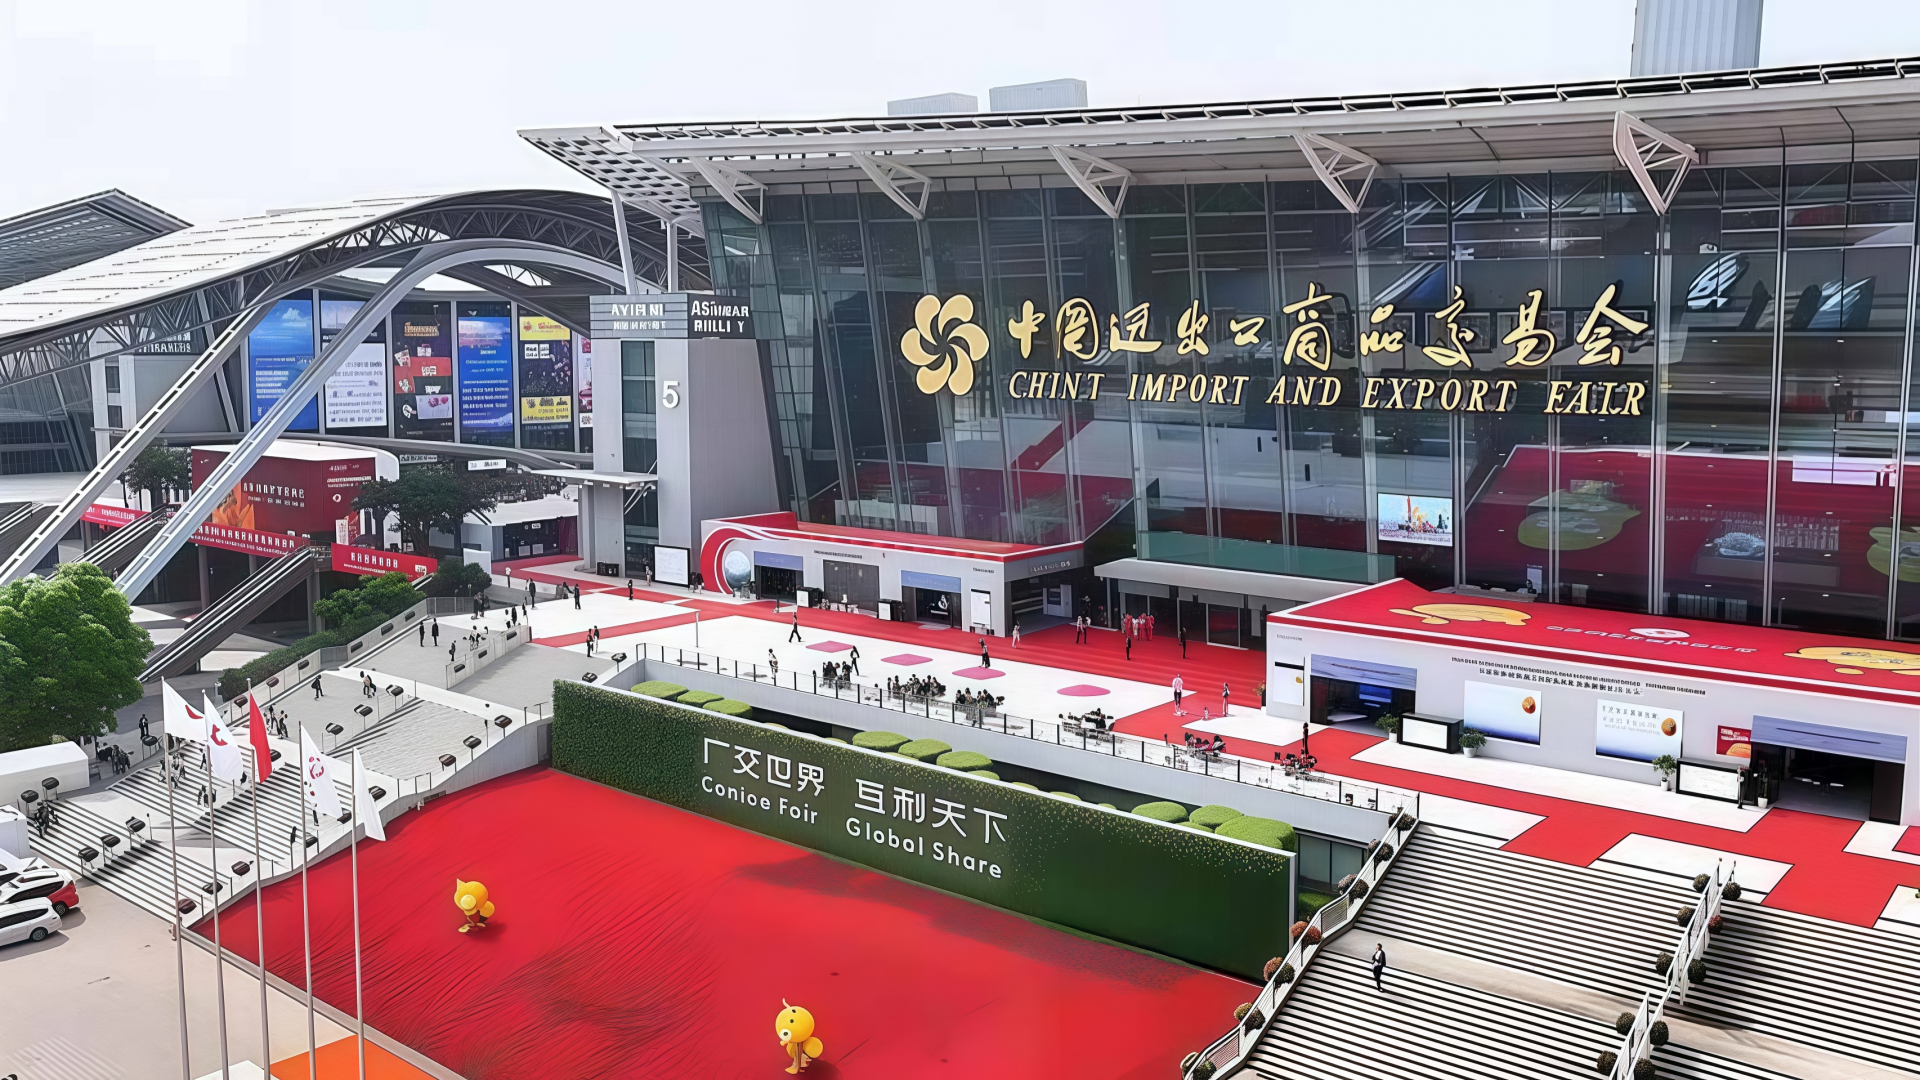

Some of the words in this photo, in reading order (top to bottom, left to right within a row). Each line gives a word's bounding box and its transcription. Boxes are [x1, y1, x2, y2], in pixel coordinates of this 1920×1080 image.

[662, 380, 680, 409] 5
[1008, 371, 1106, 401] CHINT
[1127, 373, 1250, 405] IMPORT
[1265, 375, 1342, 407] AND
[1360, 376, 1518, 413] EXPORT
[1543, 380, 1646, 416] FAIR
[854, 778, 1008, 844] 互利天下
[932, 841, 1002, 879] Share
